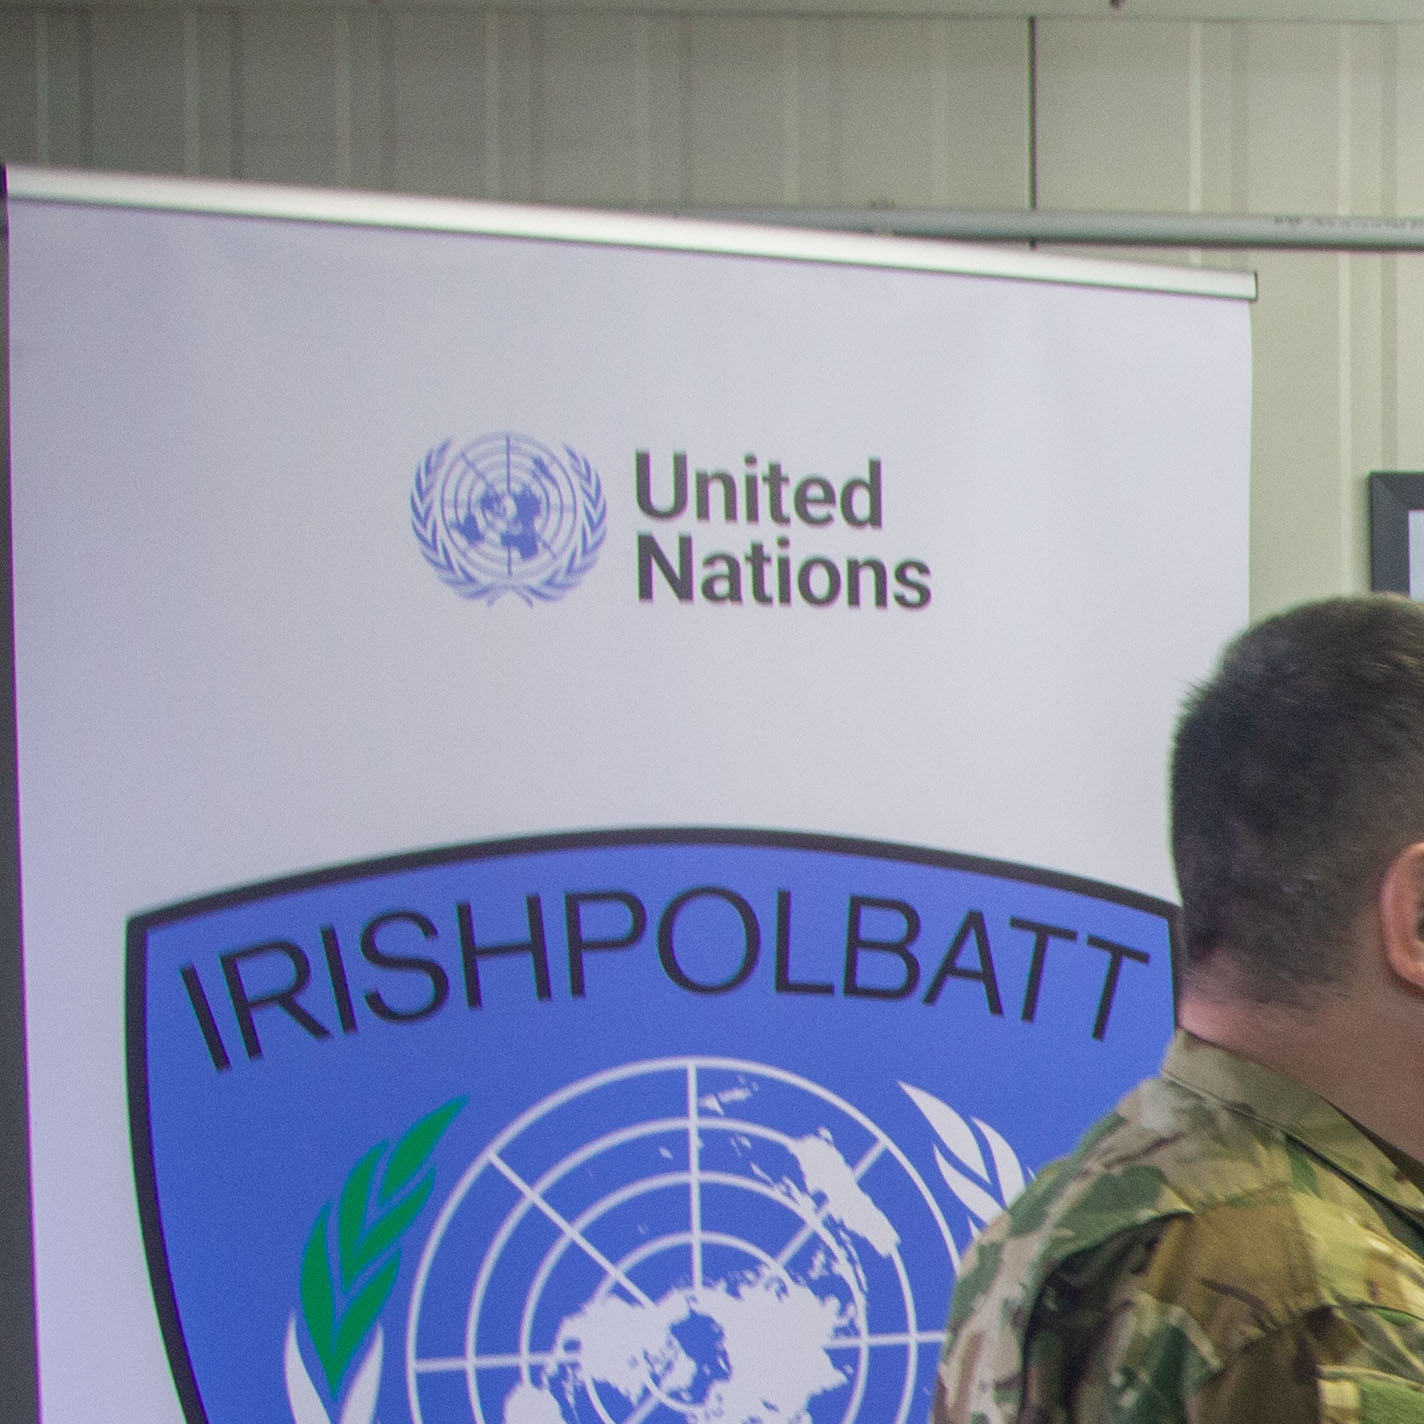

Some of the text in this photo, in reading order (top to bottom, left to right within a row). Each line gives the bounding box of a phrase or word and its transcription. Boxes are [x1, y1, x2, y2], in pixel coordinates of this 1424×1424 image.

[633, 448, 883, 530] United
[635, 532, 932, 611] Nations
[179, 885, 1151, 1072] IRISHPOLBATT
